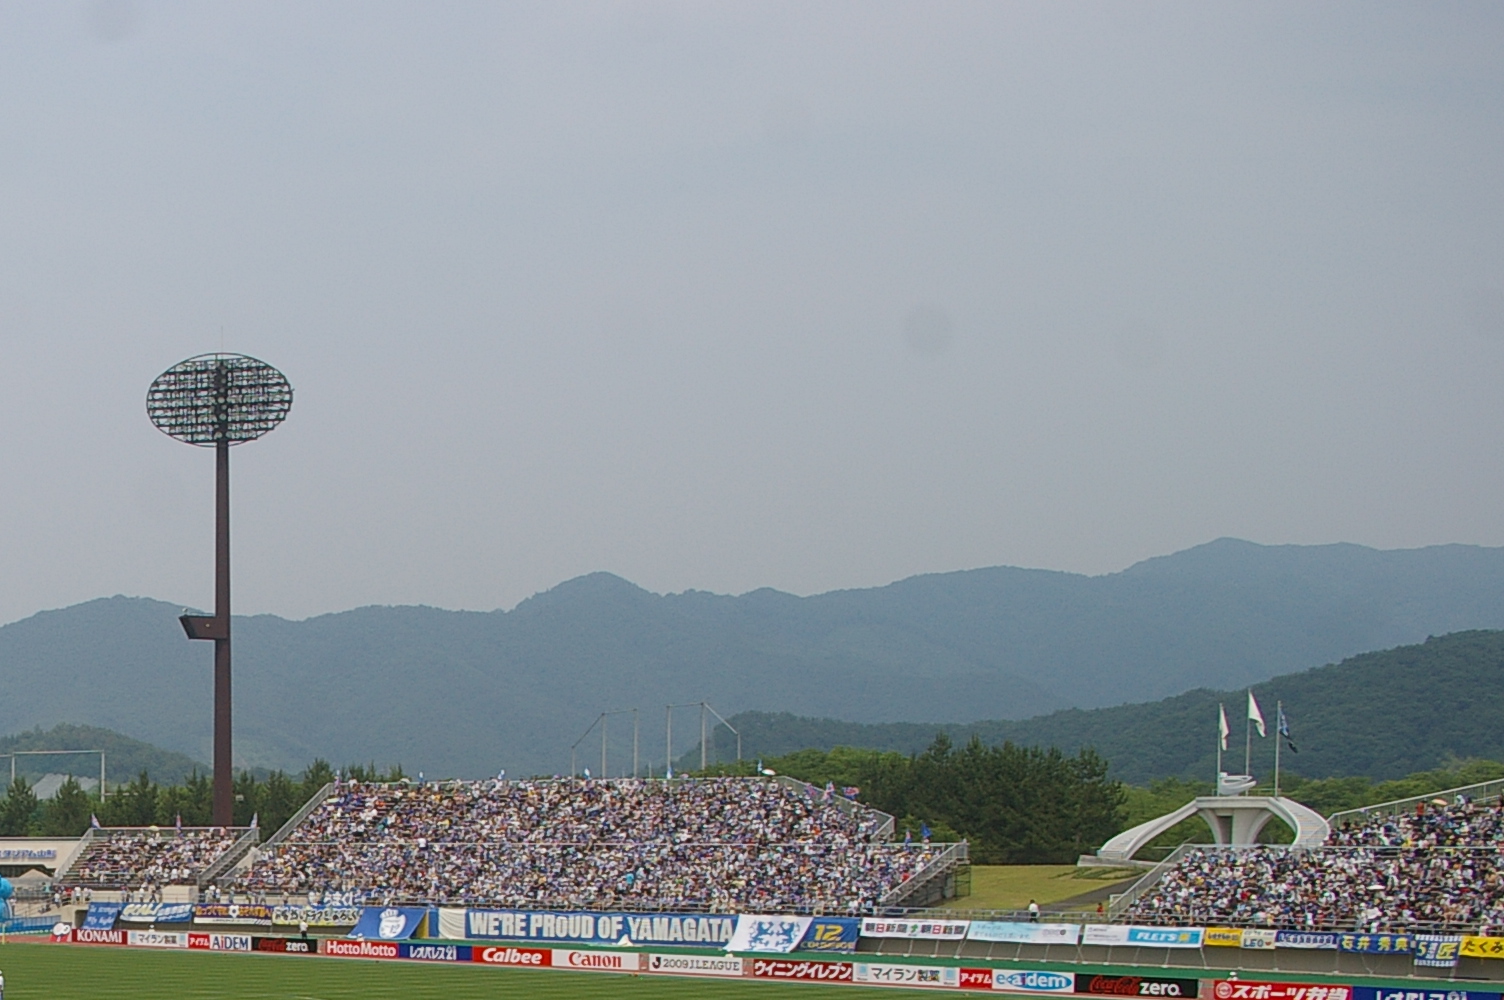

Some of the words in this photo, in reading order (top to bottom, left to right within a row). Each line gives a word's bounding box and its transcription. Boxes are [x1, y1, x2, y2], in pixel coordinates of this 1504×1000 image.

[469, 911, 526, 936] WE'RE
[530, 914, 594, 939] PROUD
[597, 915, 624, 940] OF
[628, 916, 734, 943] YAMAGATA
[77, 929, 123, 943] KONAMI
[1341, 935, 1370, 950] 石井
[285, 941, 309, 952] zero
[482, 947, 542, 965] Calbee
[568, 951, 622, 968] Canon
[754, 960, 851, 980] ウイニングイレブン
[1140, 981, 1181, 996] zero
